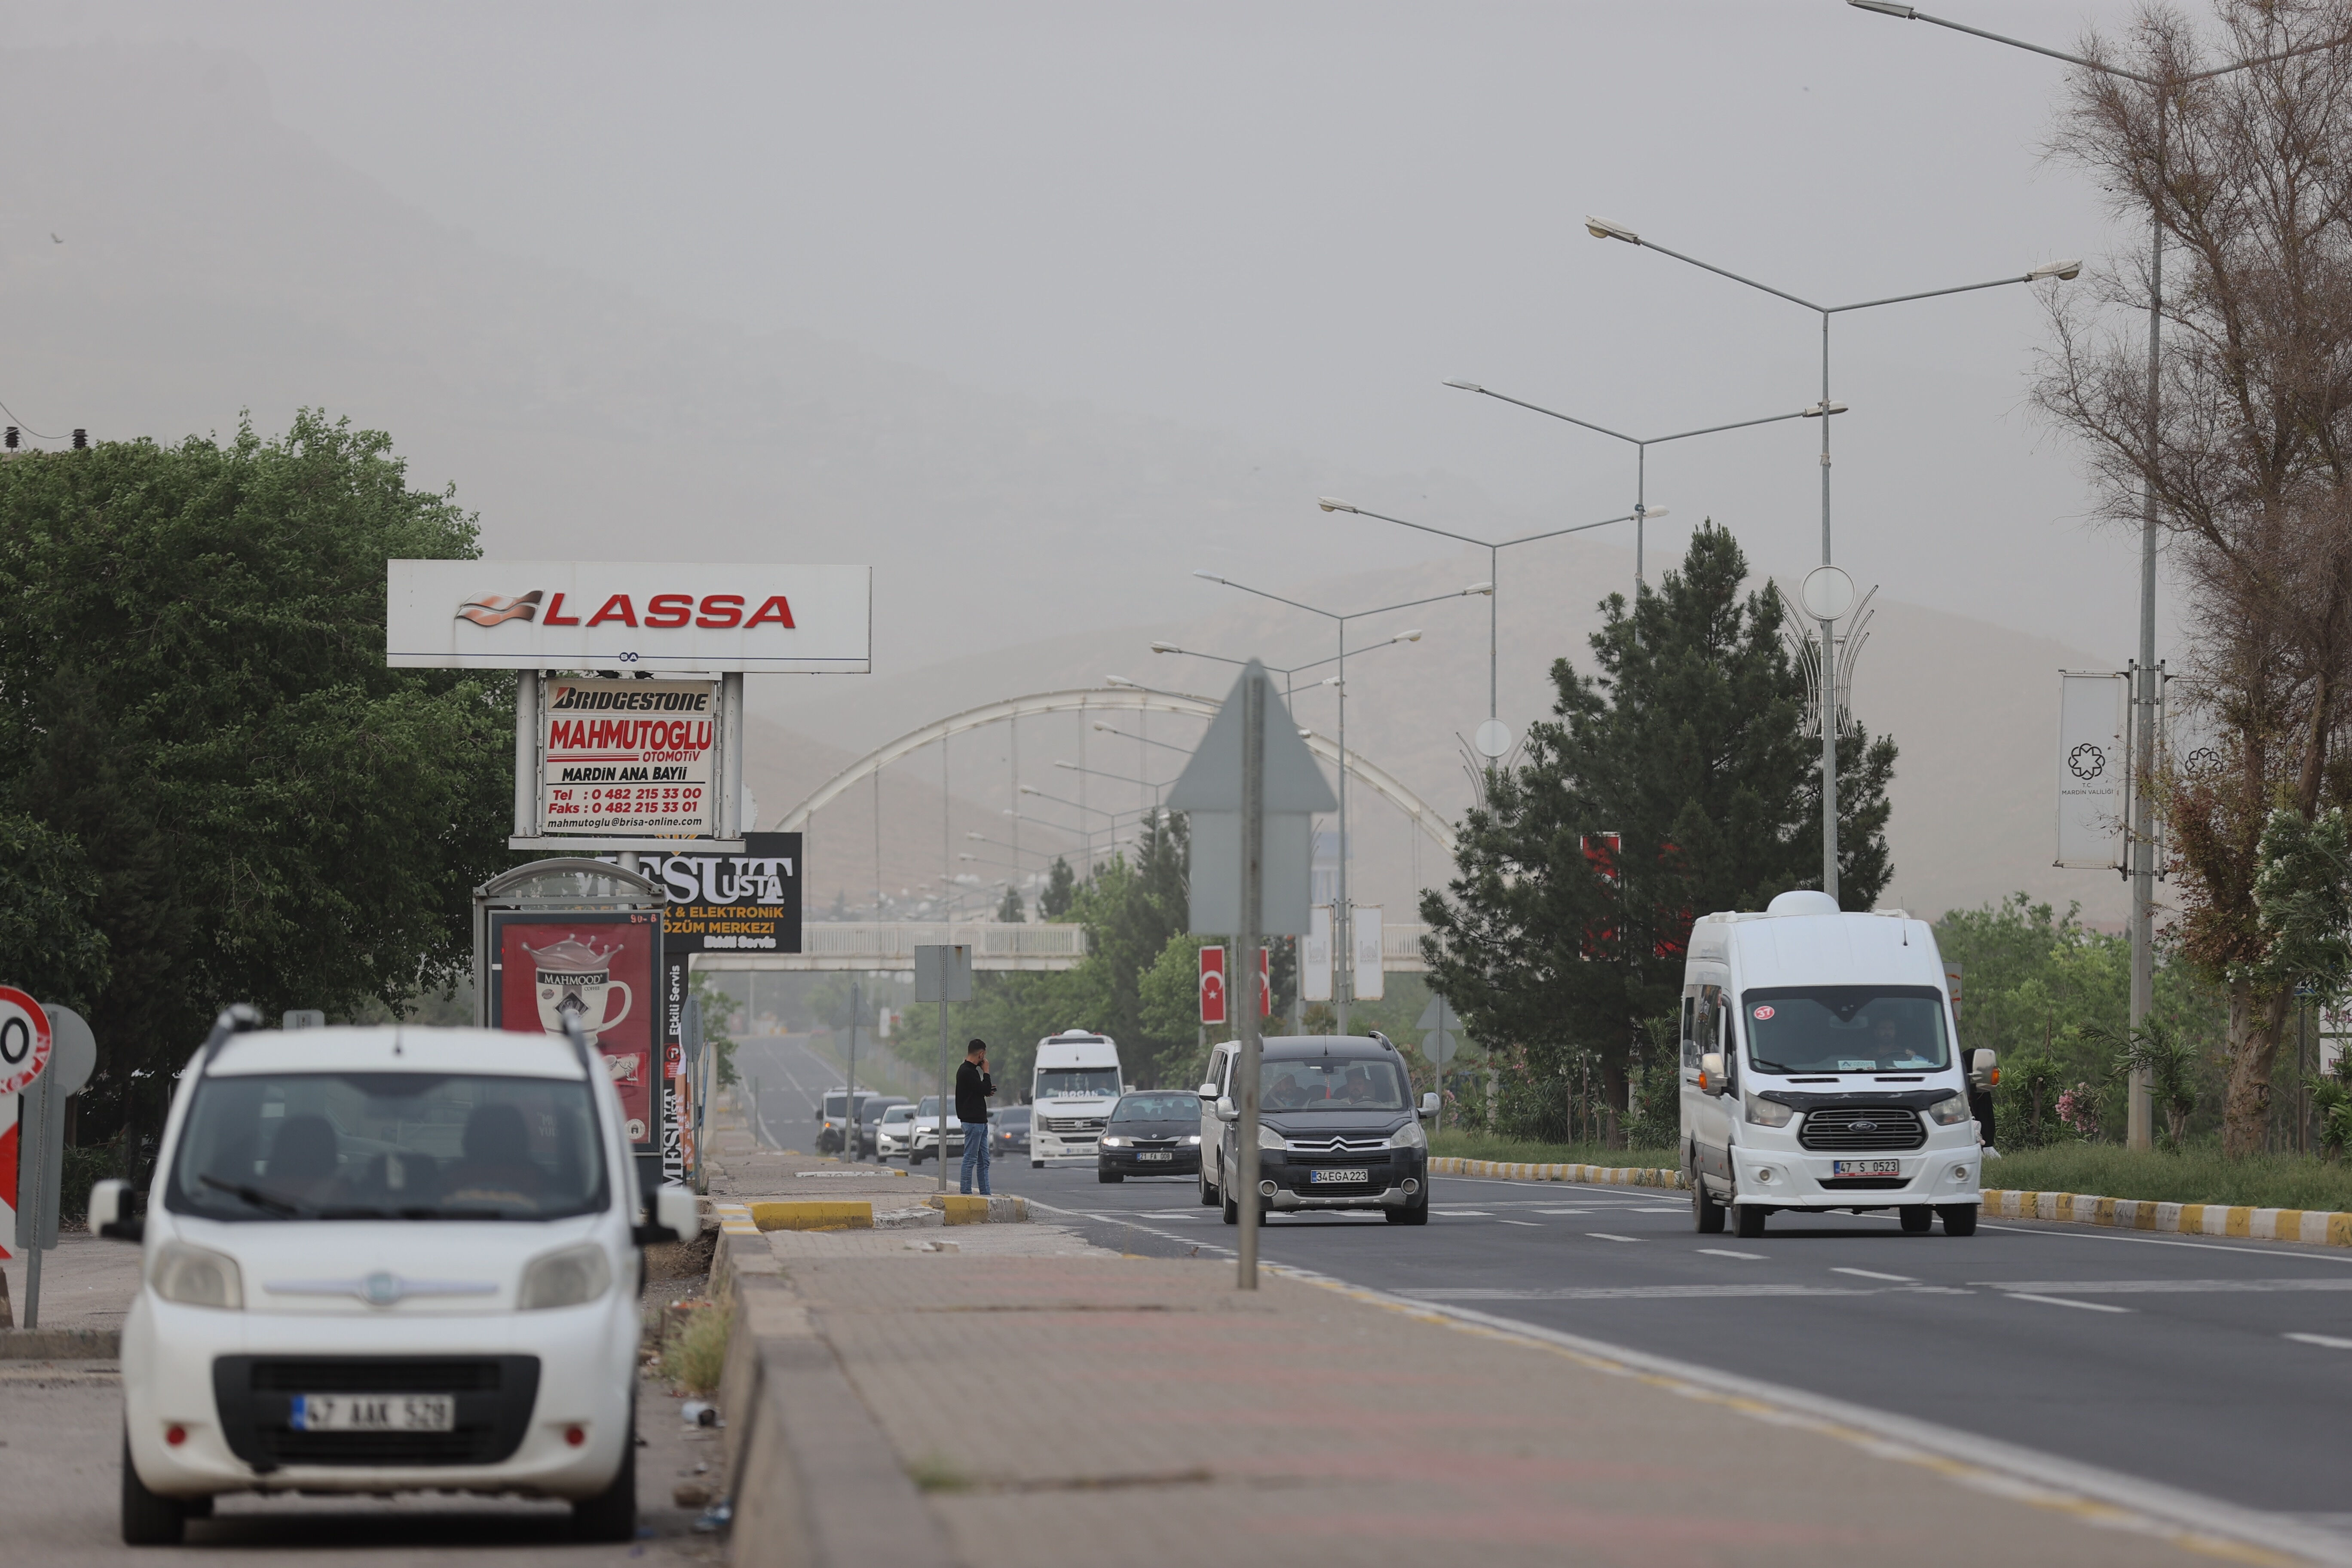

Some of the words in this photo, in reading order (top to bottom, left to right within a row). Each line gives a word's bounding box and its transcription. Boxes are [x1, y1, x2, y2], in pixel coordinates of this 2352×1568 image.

[543, 593, 796, 628] LASSA
[552, 687, 708, 710] BRIDGESTONE
[549, 720, 712, 750] MAHMUTOGLU
[619, 767, 648, 780] ANA
[553, 790, 572, 800] Tel
[592, 790, 601, 799] 0
[605, 789, 631, 799] 482
[636, 789, 658, 799] 215
[662, 788, 679, 799] 33
[683, 788, 701, 798] 00
[548, 803, 579, 814] Faks
[592, 802, 601, 813] 0
[605, 803, 631, 812] 482
[634, 802, 658, 812] 215
[662, 802, 678, 812] 33
[682, 802, 698, 812] 01
[548, 818, 702, 828] mahmutoglu@brisa-online.com
[723, 874, 784, 897] USTA
[544, 973, 600, 985] MAHMOOD
[669, 965, 680, 1001] Servis
[669, 1004, 680, 1035] Etkili
[1758, 1008, 1771, 1018] 37
[1841, 1163, 1851, 1172] 47
[1860, 1162, 1865, 1172] S
[1874, 1161, 1896, 1172] 0523
